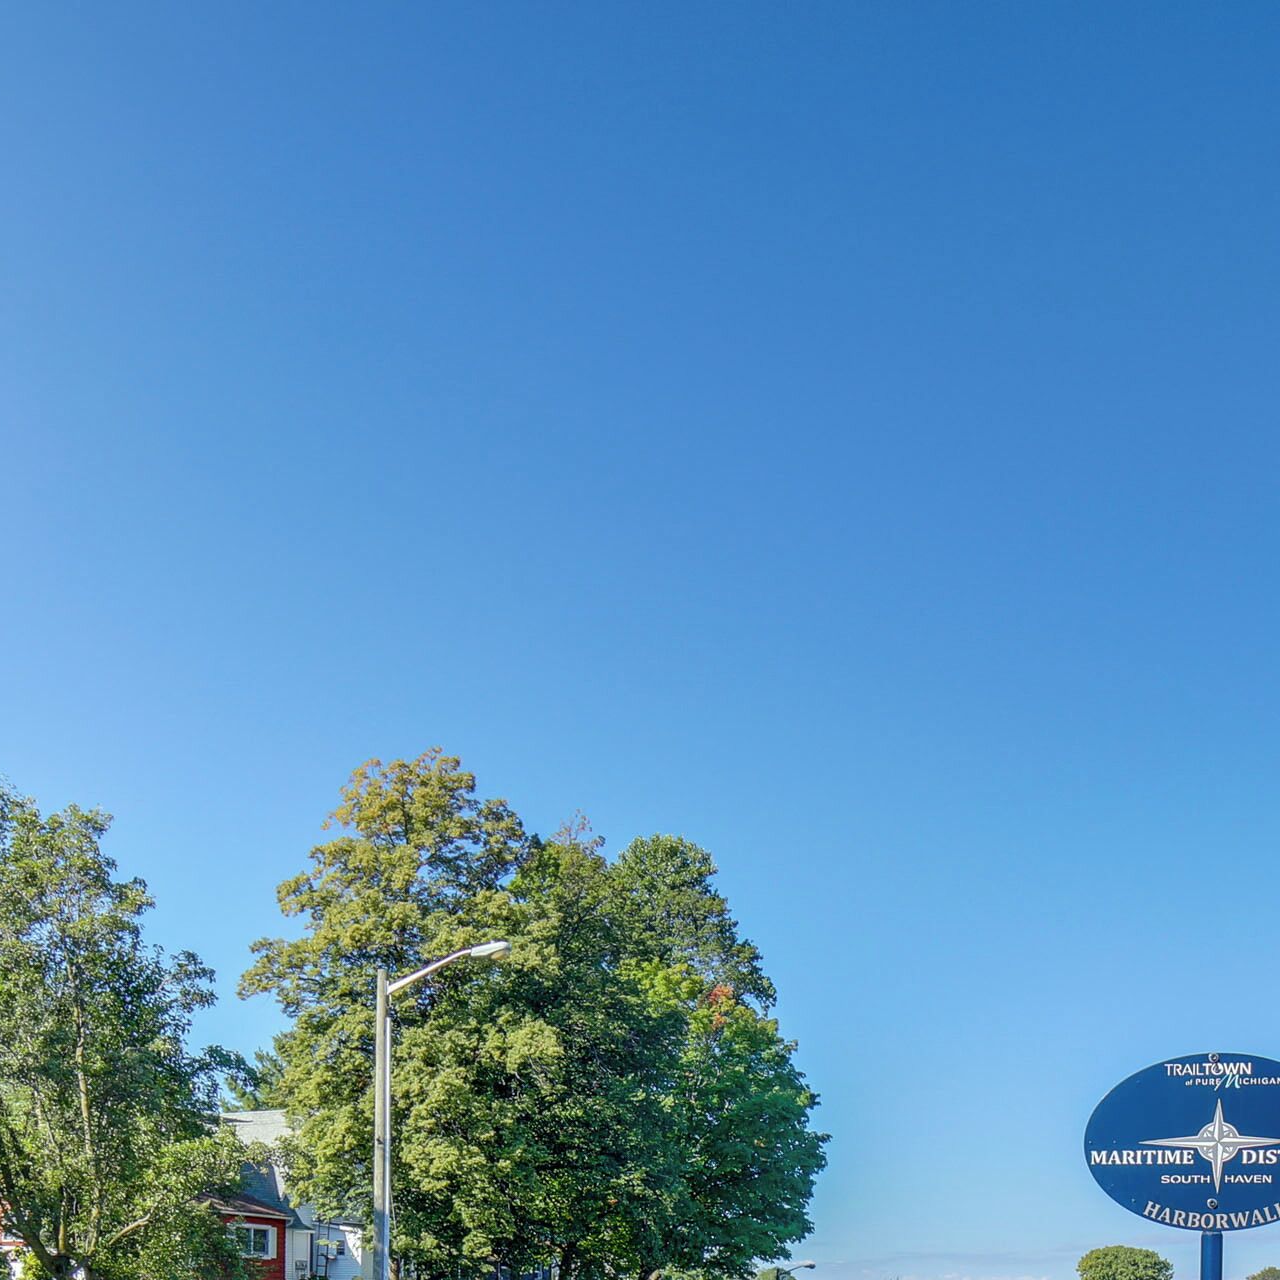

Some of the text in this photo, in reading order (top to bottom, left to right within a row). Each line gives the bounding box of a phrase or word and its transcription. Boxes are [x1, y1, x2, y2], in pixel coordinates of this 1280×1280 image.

[1195, 1078, 1221, 1086] PURE
[1090, 1150, 1194, 1165] MARITIME
[1160, 1174, 1273, 1184] SOUTH HAVEN
